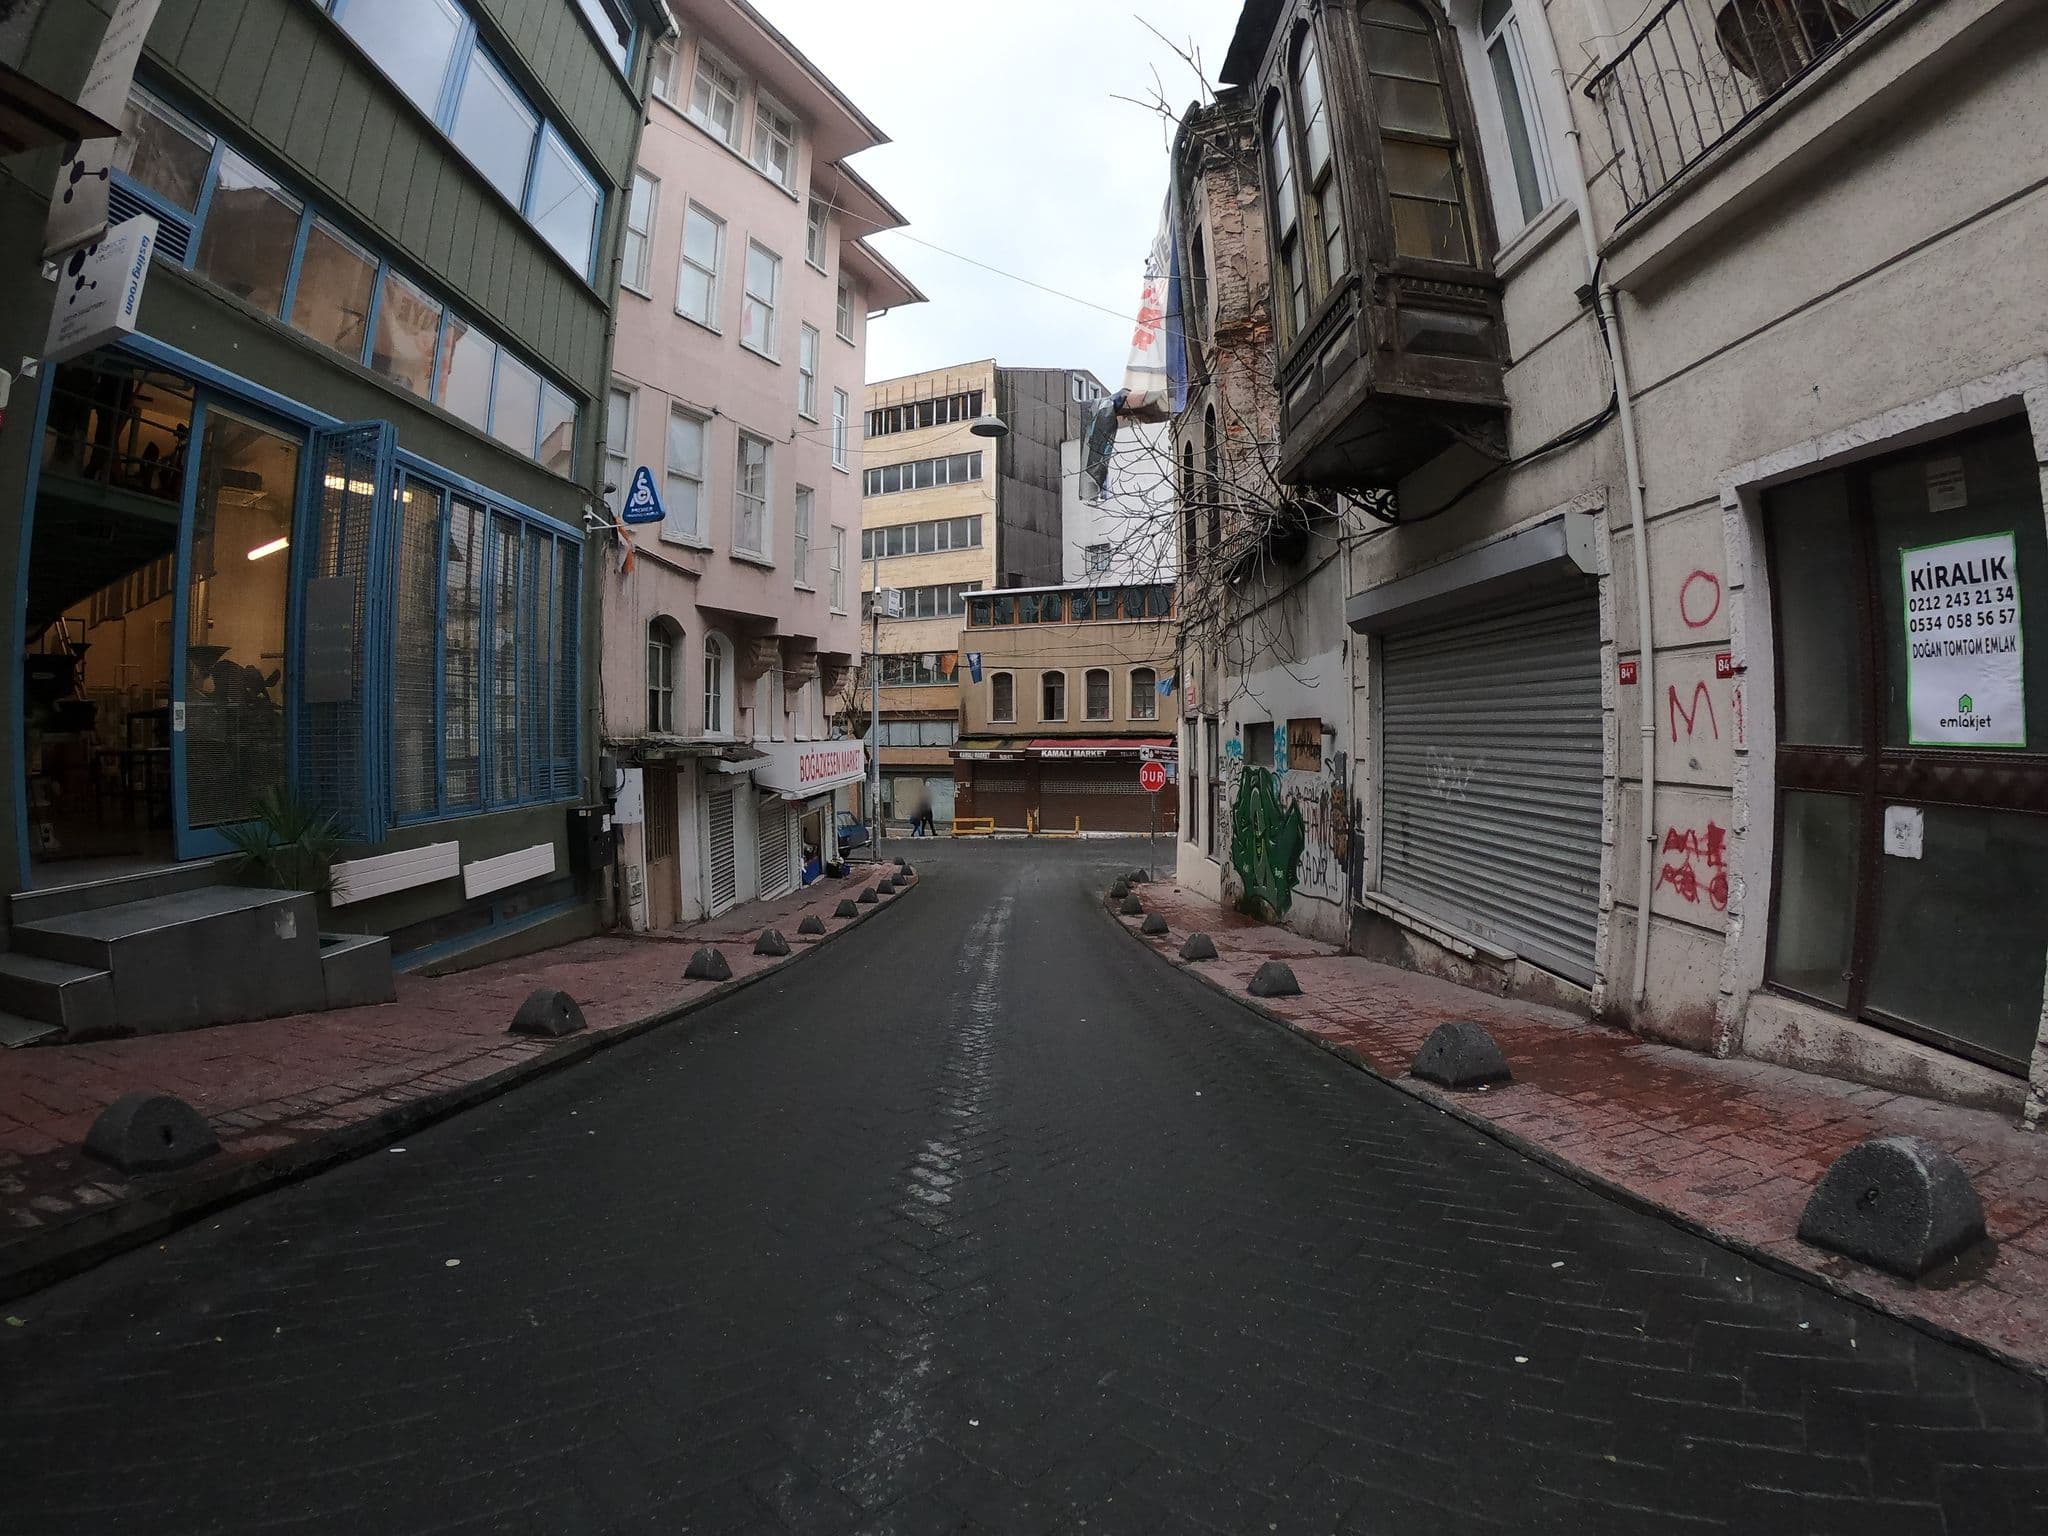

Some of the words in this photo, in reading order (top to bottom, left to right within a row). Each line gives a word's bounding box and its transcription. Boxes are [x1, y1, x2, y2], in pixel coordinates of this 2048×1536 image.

[132, 235, 150, 279] tasting
[125, 279, 138, 316] room
[1911, 555, 2008, 592] KİRALIK
[1910, 597, 1941, 613] 0212
[1946, 594, 1971, 608] 243
[1976, 590, 1993, 605] 21
[1997, 586, 2014, 602] 34
[1910, 616, 1942, 633] 0534
[1947, 613, 1973, 629] 058
[1977, 611, 1994, 626] 56
[1999, 608, 2016, 624] 57
[1912, 638, 1942, 659] DOĞAN
[1943, 638, 1983, 657] TOMTOM
[1985, 634, 2016, 653] EMLAK
[1718, 658, 1730, 672] 84
[1940, 713, 1992, 732] emlakjet
[1142, 770, 1164, 783] DUR
